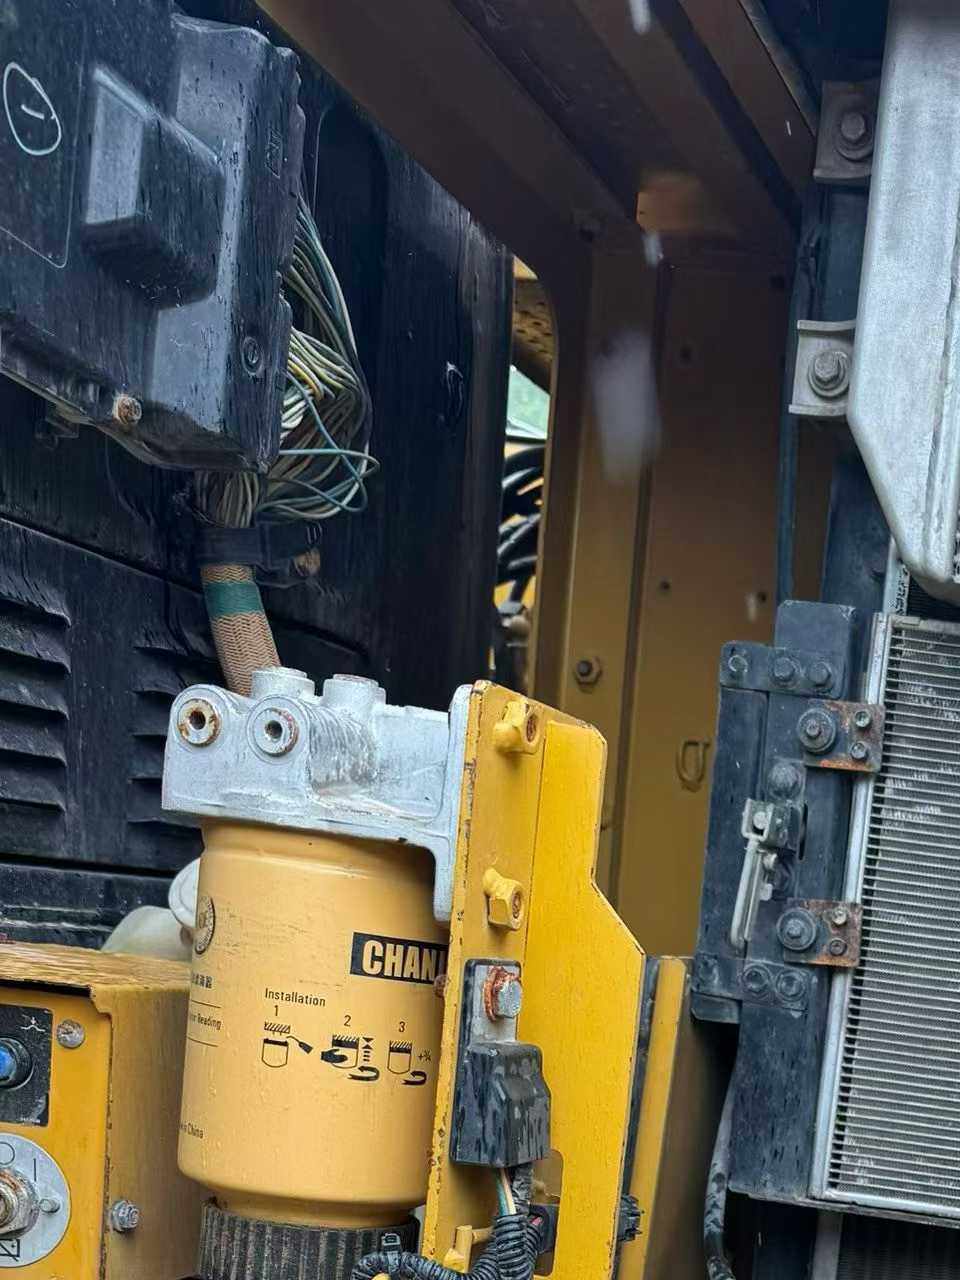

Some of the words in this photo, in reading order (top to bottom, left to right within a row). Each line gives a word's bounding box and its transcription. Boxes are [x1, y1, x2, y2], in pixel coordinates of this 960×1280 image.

[264, 987, 326, 1007] Installation
[274, 1005, 279, 1016] 1
[343, 1015, 352, 1027] 2
[398, 1021, 406, 1033] 3
